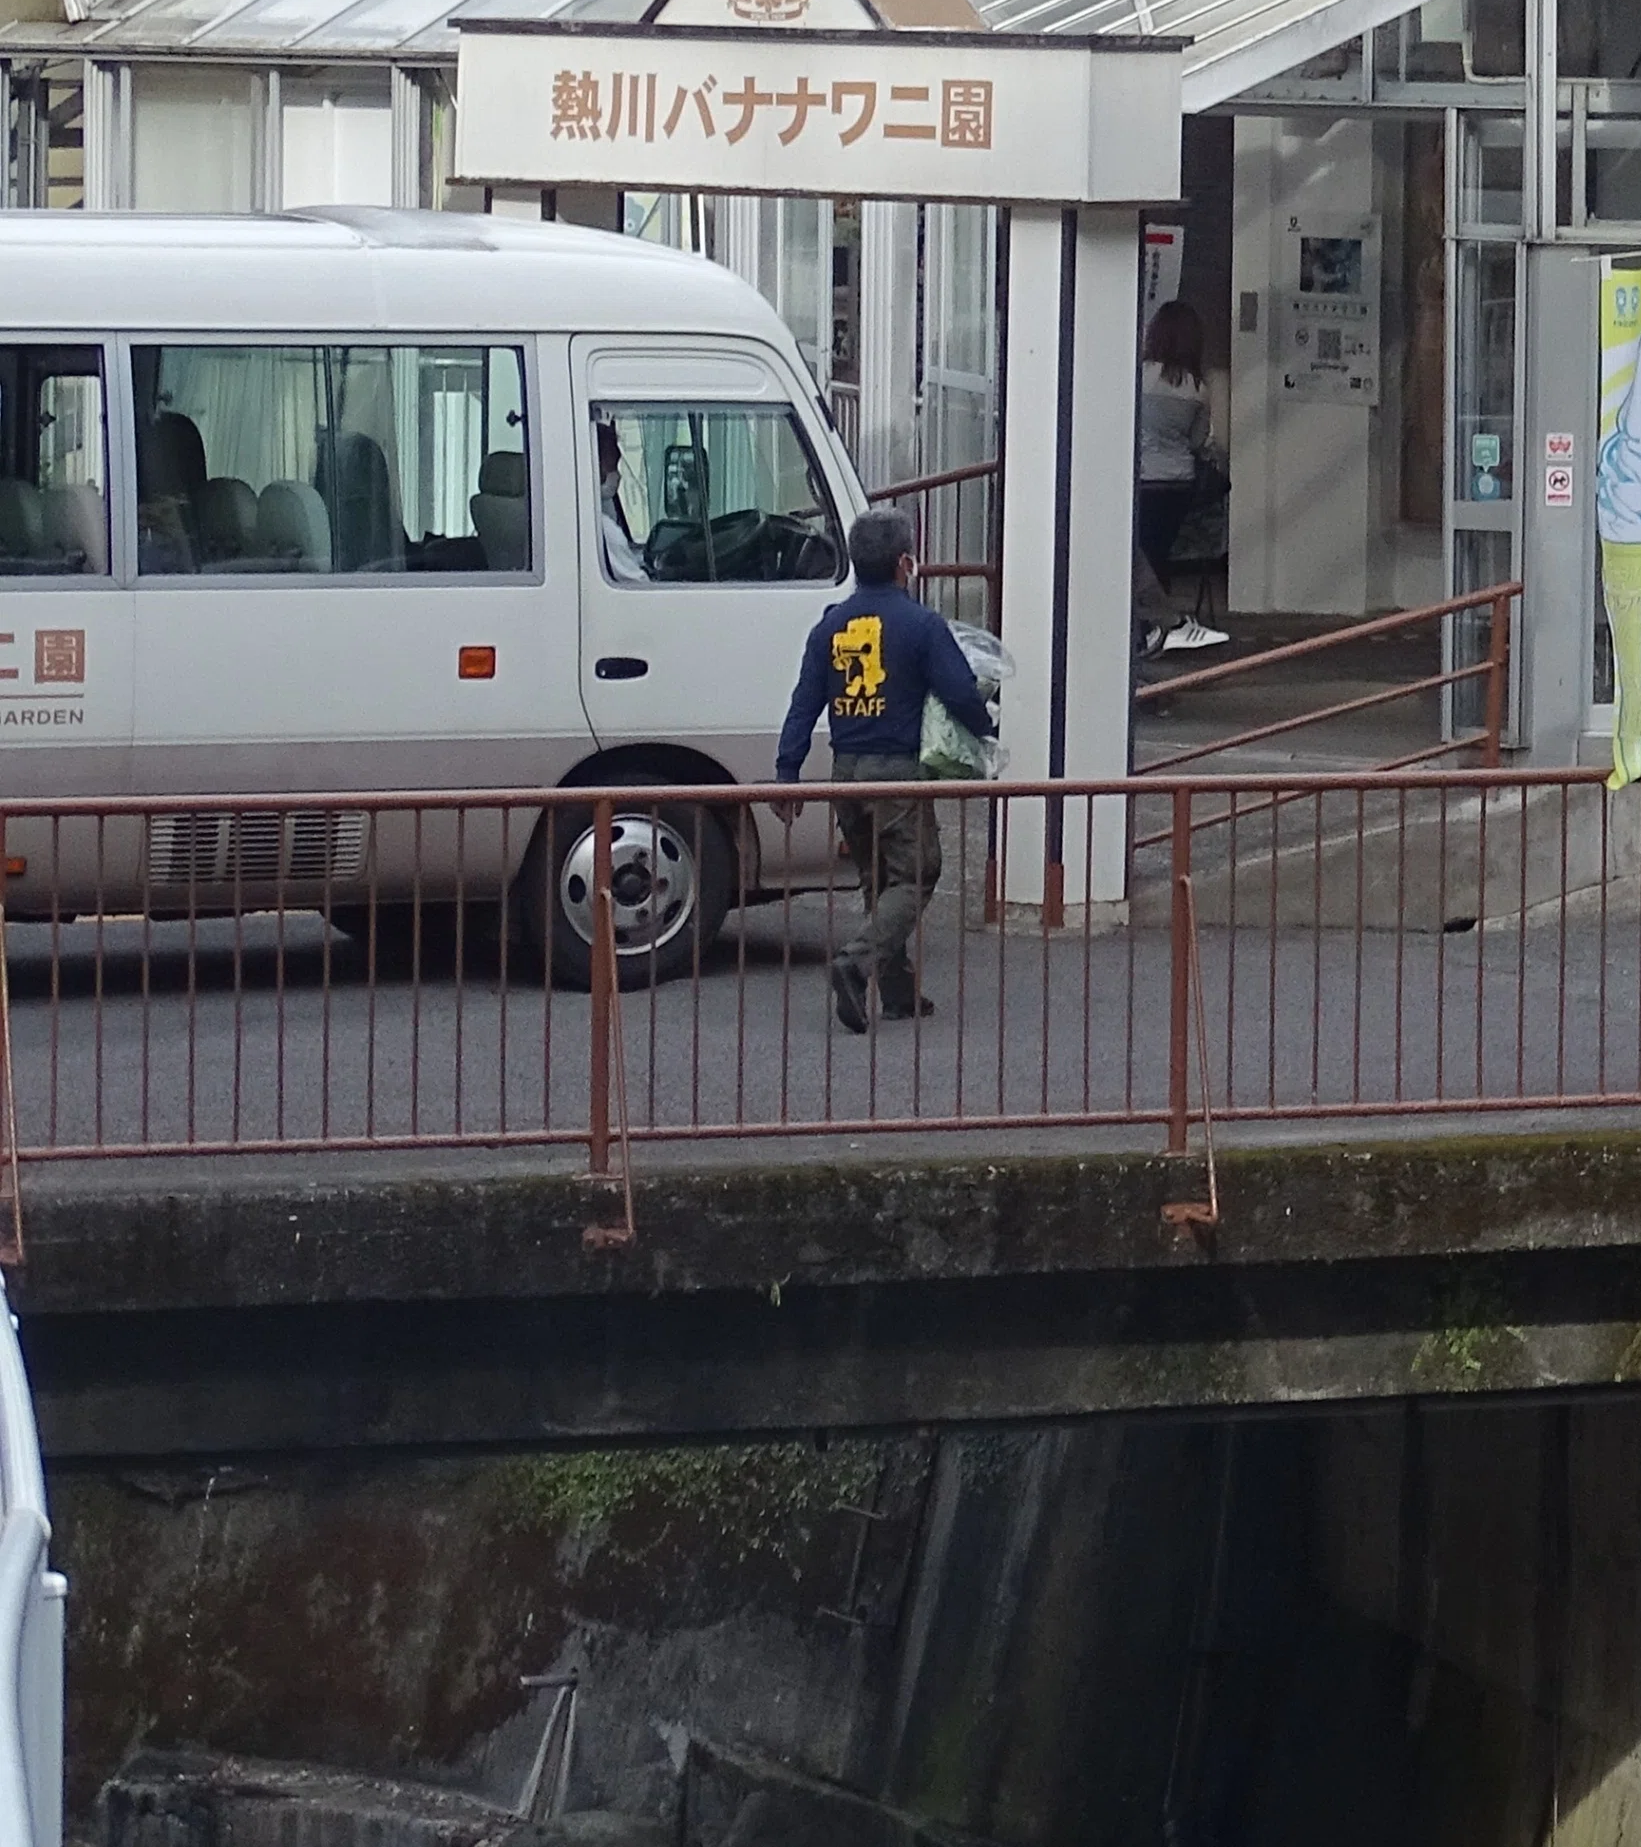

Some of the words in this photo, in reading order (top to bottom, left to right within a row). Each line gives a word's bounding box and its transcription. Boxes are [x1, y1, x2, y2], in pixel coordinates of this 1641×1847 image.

[548, 68, 994, 150] 熱川バナナワニ園
[0, 708, 85, 726] ARDEN
[833, 696, 887, 718] STAFF
